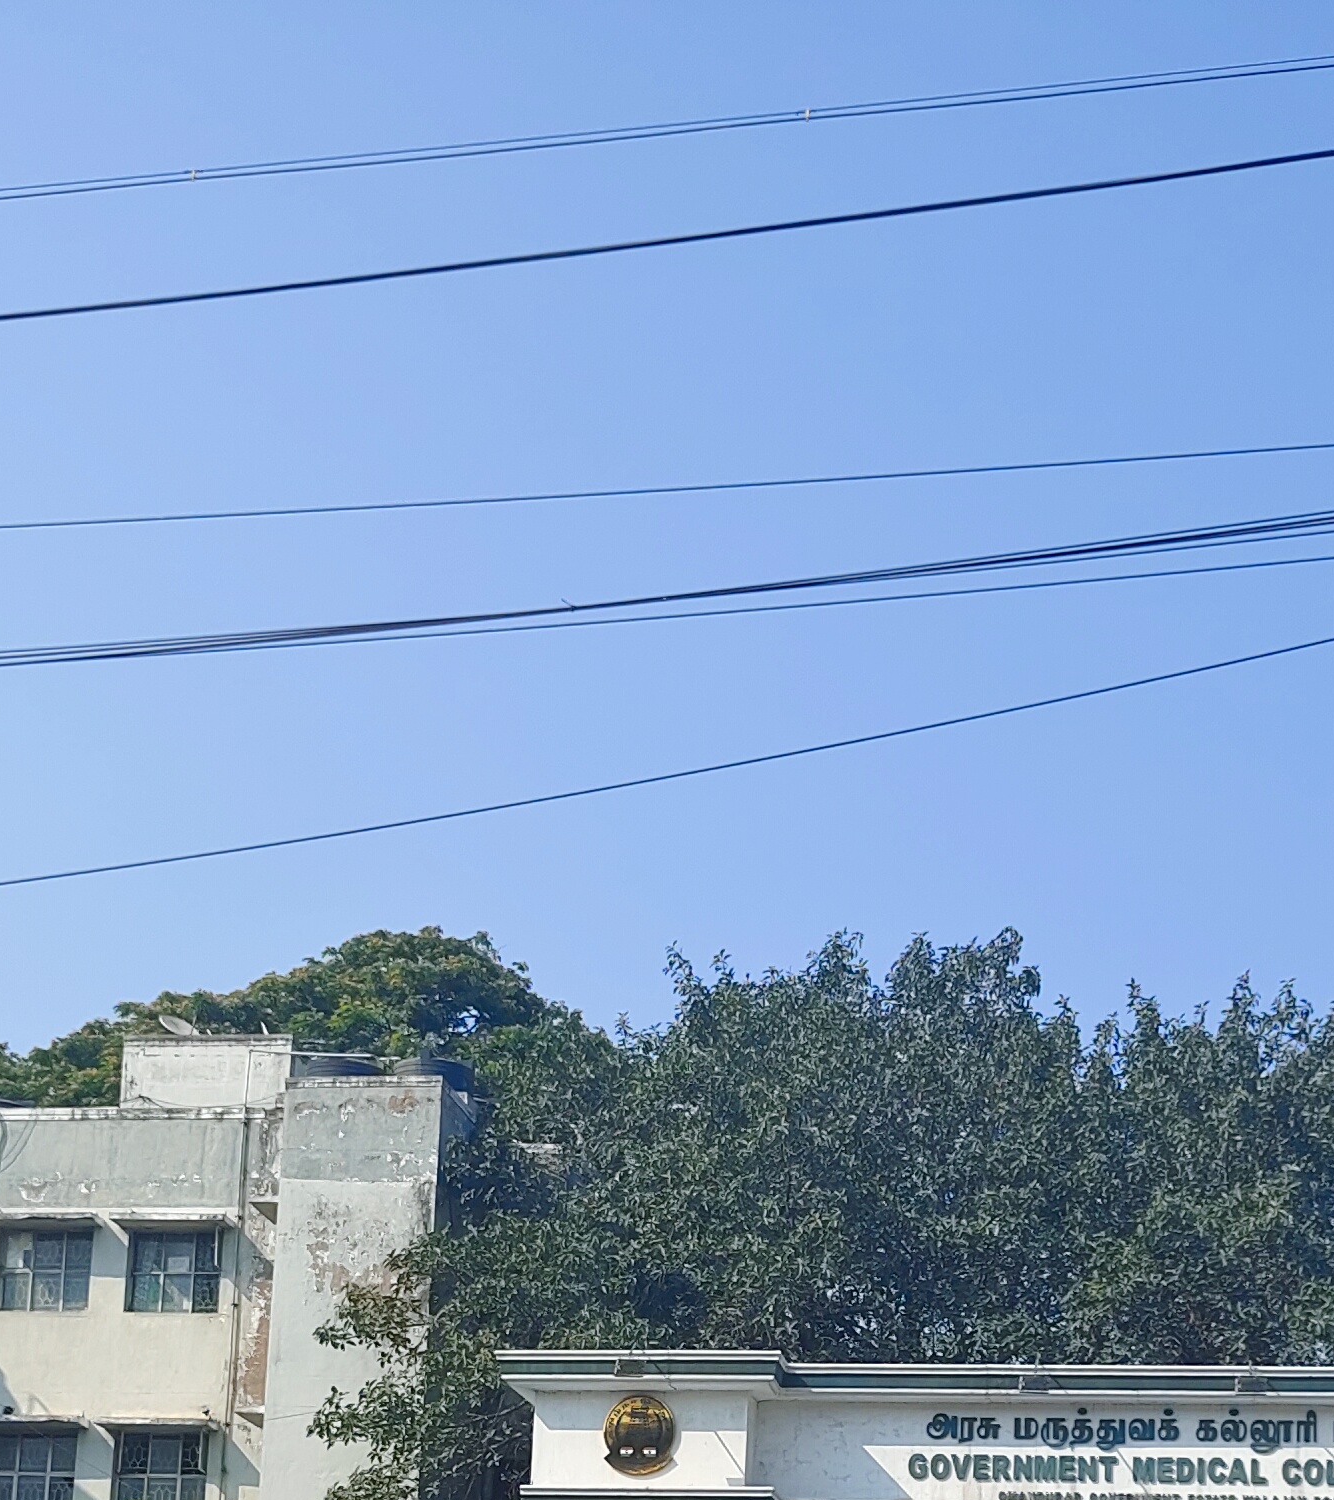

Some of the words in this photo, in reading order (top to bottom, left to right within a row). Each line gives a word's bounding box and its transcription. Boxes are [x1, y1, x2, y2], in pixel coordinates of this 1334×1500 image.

[926, 1412, 1001, 1444] அரசு
[1014, 1407, 1179, 1449] மருத்துவக்
[1196, 1408, 1318, 1454] கல்லூரி
[908, 1453, 1120, 1485] GOVERNMENT
[1131, 1456, 1269, 1487] MEDICAL
